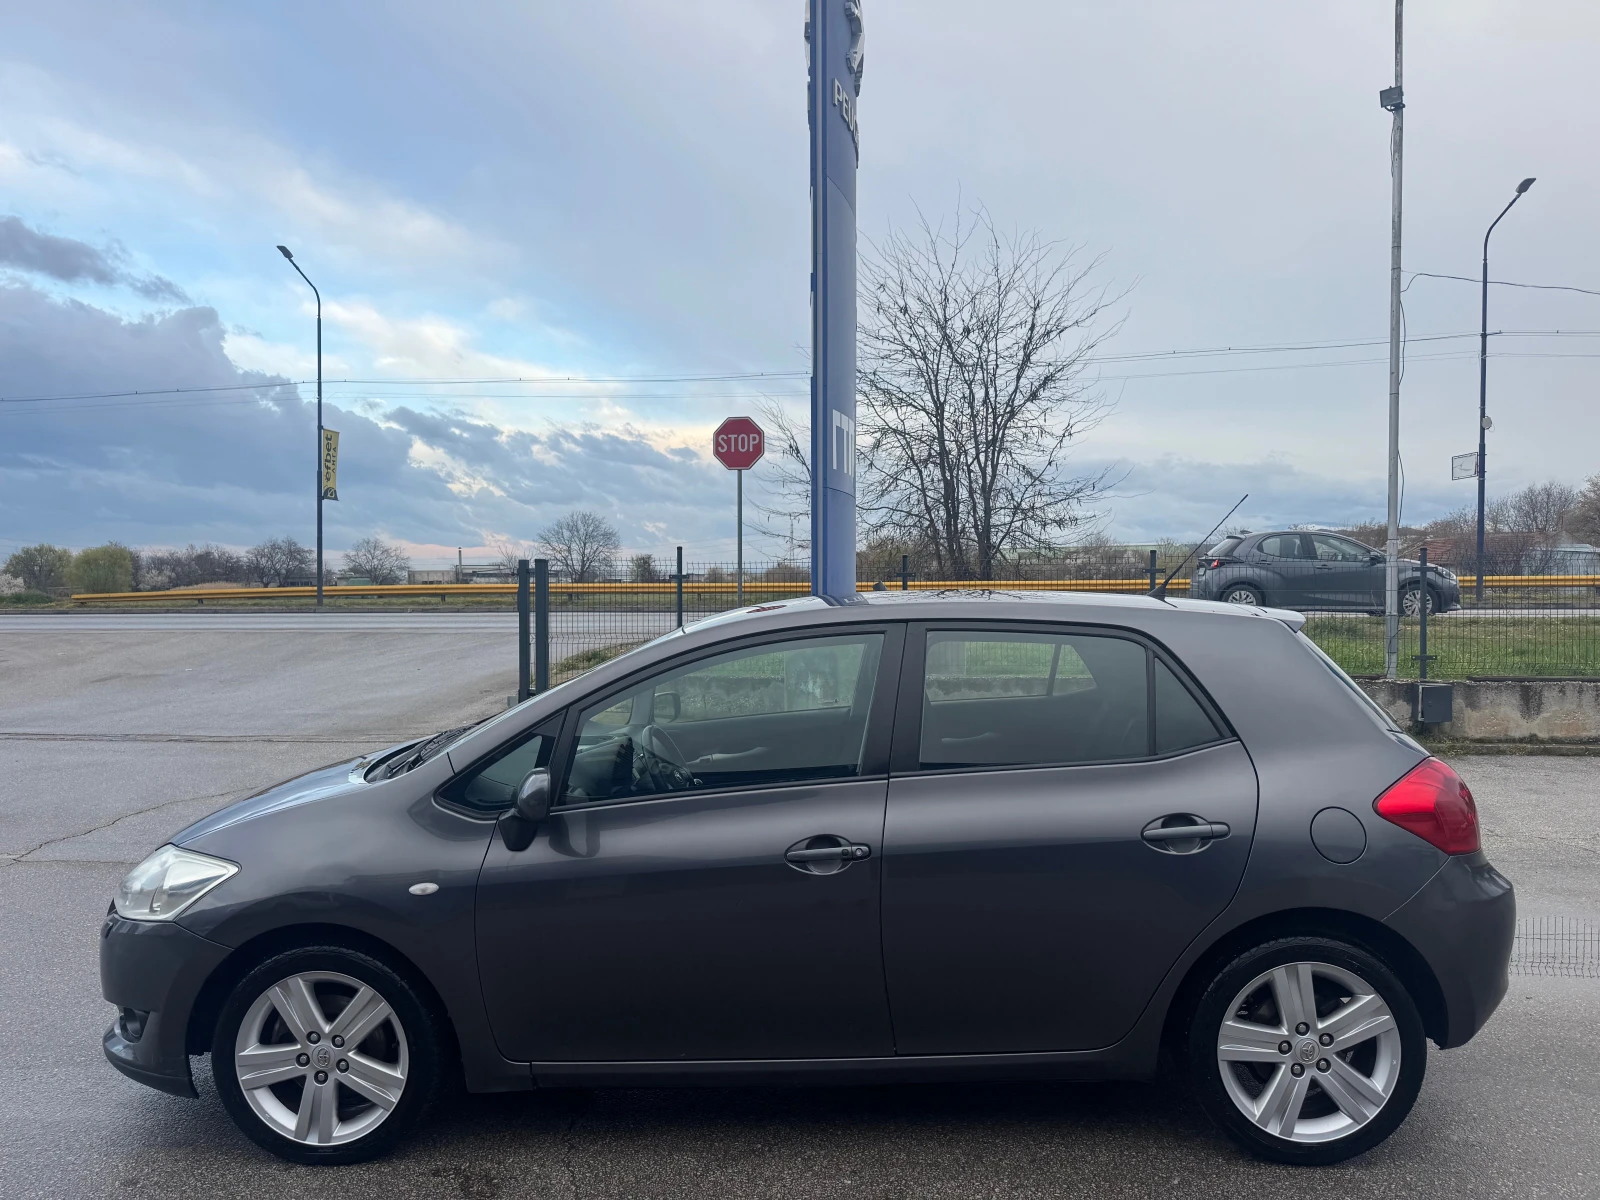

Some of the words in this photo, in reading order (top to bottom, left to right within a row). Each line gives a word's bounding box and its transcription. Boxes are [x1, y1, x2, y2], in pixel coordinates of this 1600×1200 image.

[832, 77, 859, 150] PEUG
[324, 433, 333, 483] efbet
[717, 433, 760, 453] STOP
